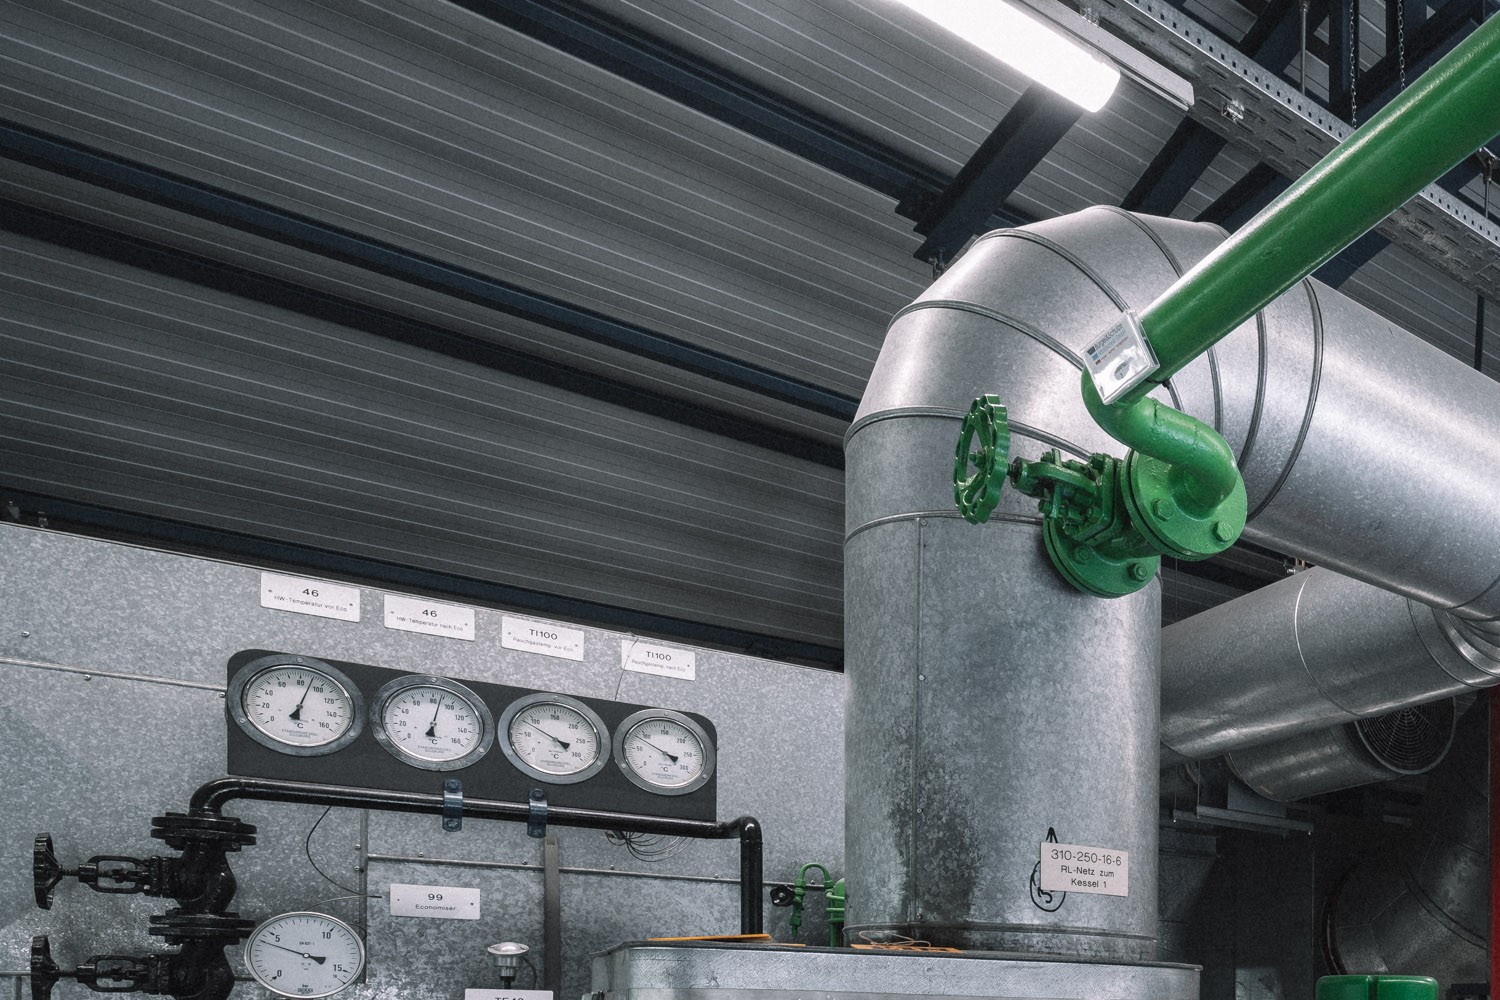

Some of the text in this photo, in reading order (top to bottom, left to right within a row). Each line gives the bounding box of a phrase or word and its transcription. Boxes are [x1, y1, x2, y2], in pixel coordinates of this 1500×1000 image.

[302, 588, 319, 597] 46
[422, 609, 438, 618] 46
[319, 721, 330, 729] 160
[1051, 848, 1122, 866] 310-250-16-6
[1061, 865, 1095, 876] RL-Netz
[1070, 878, 1099, 888] Kessel
[427, 893, 443, 901] 99
[322, 931, 331, 939] 10
[333, 964, 343, 972] 15
[277, 969, 282, 977] 0
